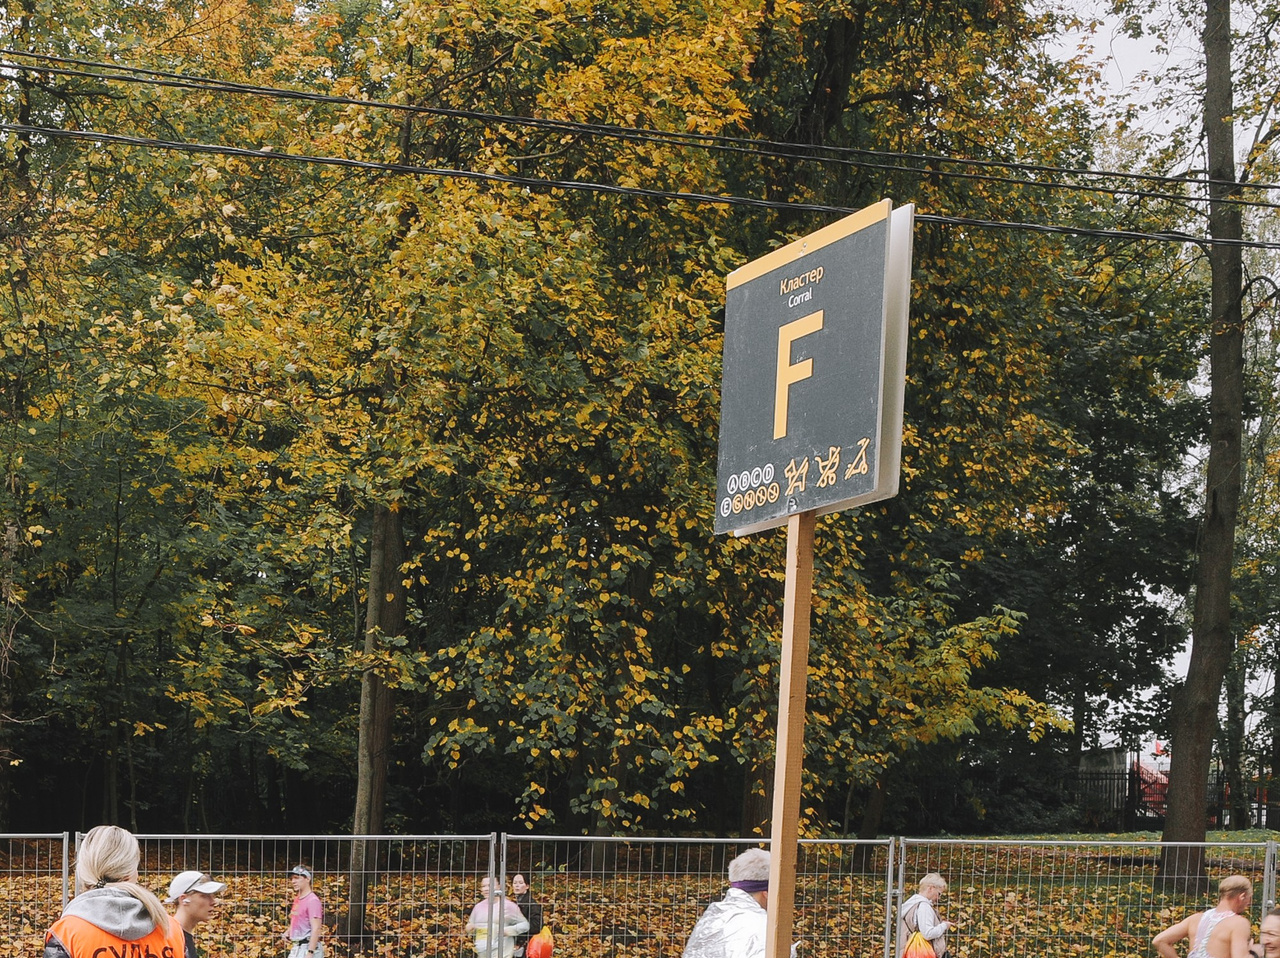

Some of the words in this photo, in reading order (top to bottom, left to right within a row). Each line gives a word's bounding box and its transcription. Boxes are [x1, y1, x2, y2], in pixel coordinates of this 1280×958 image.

[780, 266, 824, 296] Кластер
[788, 287, 812, 308] Corral
[773, 309, 824, 440] F
